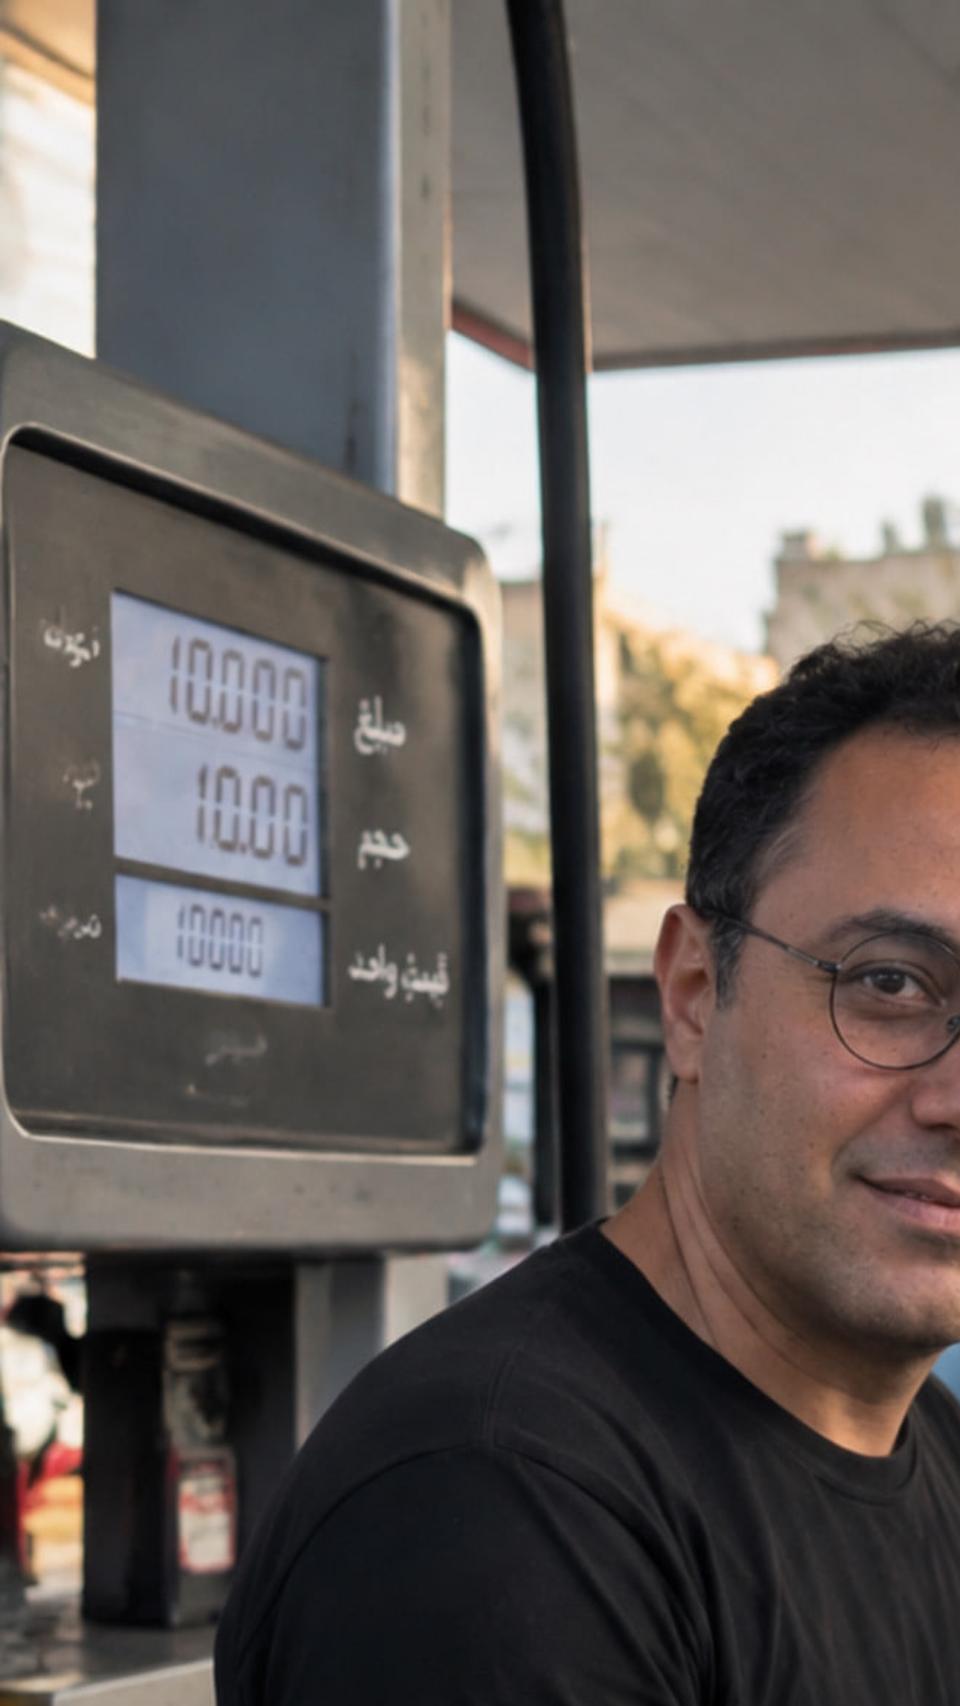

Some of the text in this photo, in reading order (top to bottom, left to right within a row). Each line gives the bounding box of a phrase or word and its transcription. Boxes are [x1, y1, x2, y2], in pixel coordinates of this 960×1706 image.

[170, 634, 308, 753] 10.000
[195, 762, 309, 868] 10.00
[176, 902, 265, 979] 10000
